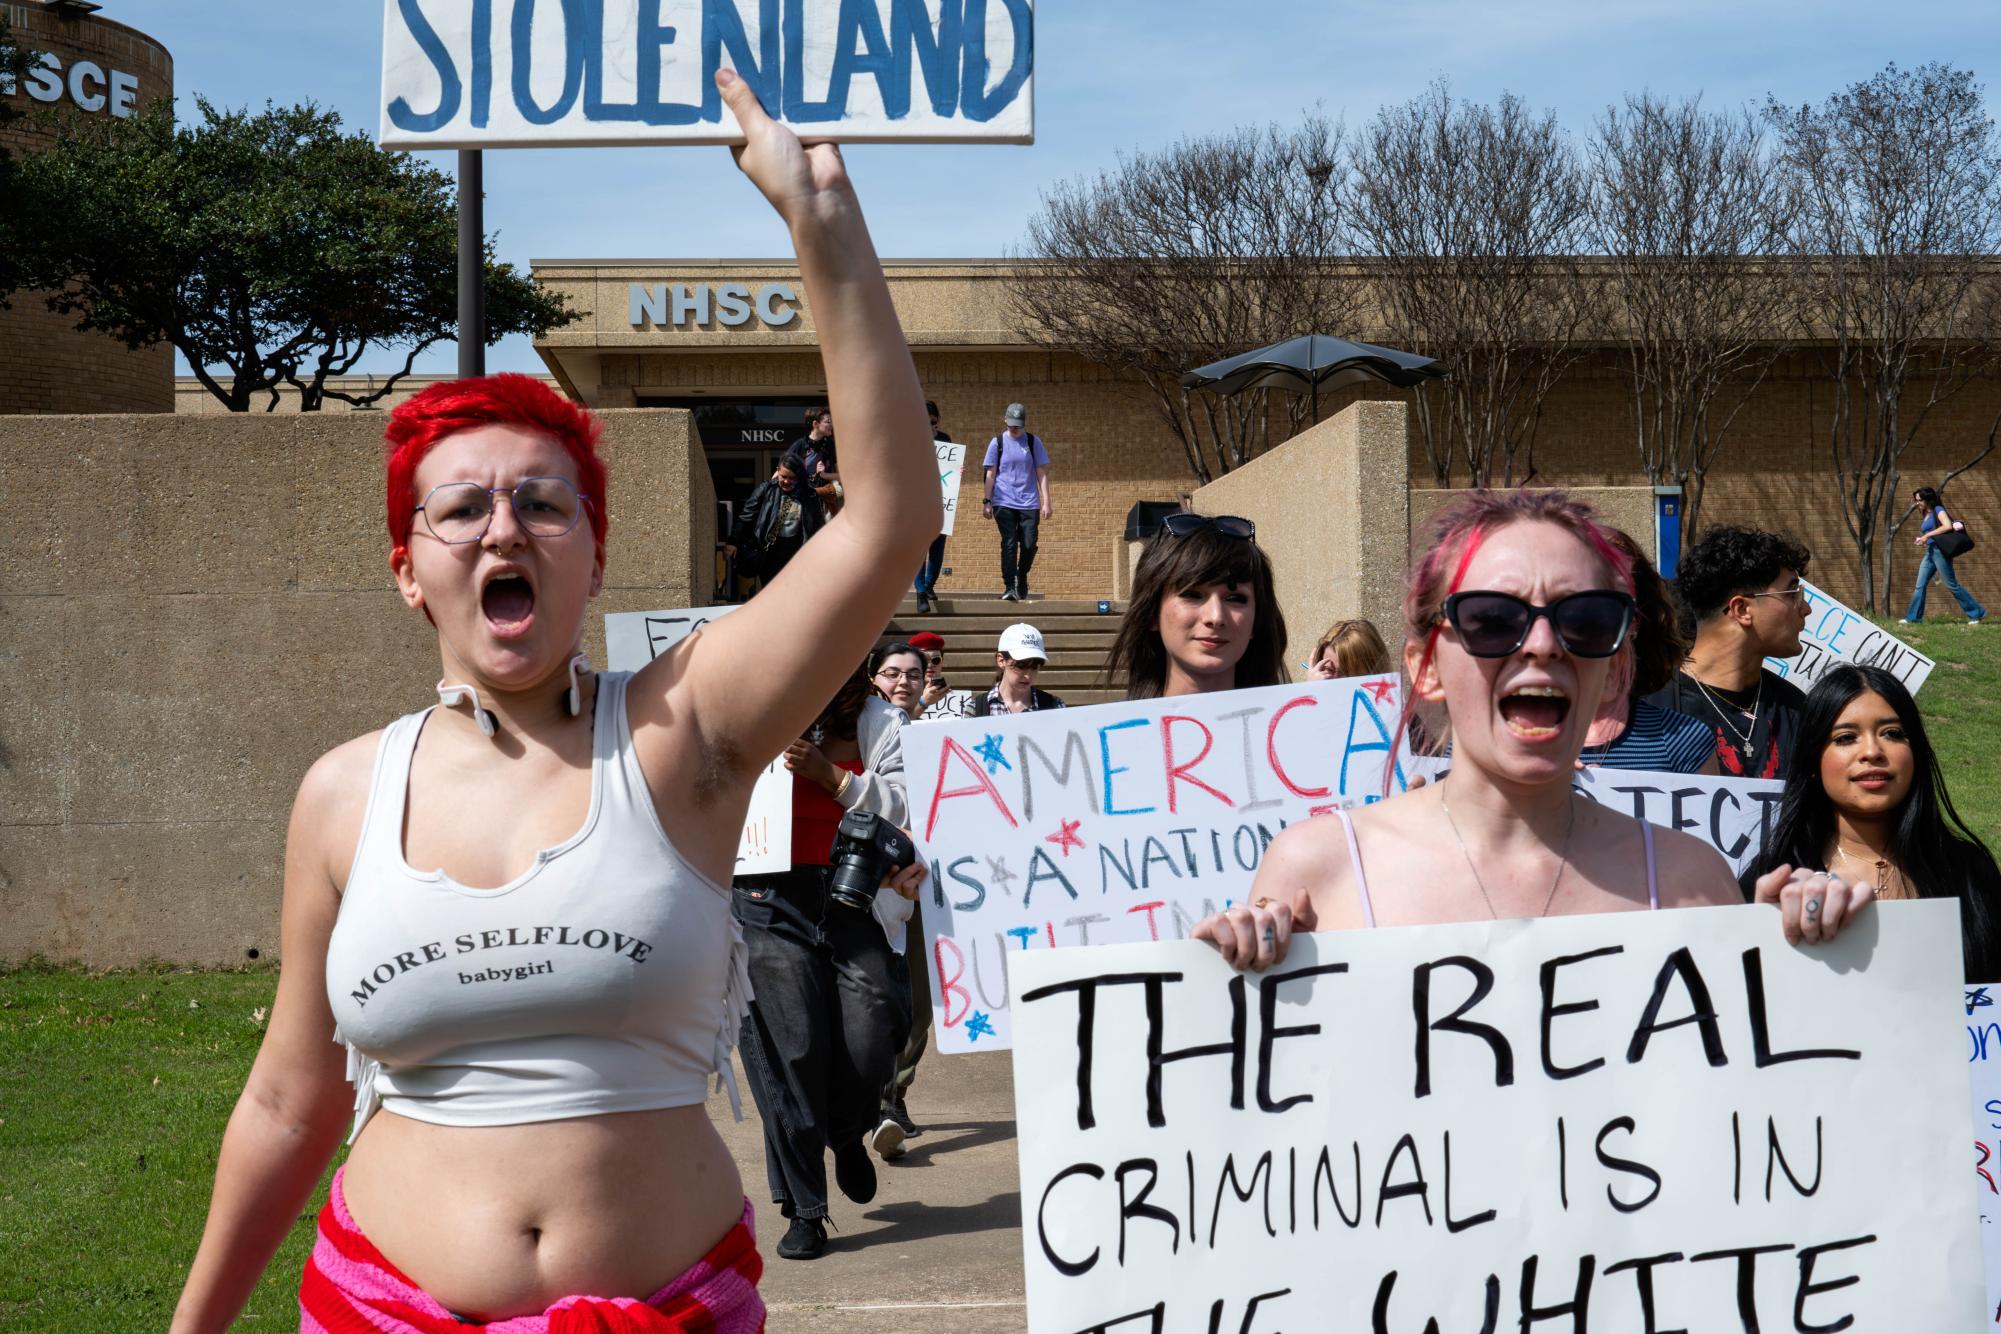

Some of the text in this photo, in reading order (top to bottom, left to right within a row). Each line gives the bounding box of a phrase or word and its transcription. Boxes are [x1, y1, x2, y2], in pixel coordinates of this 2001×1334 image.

[628, 283, 797, 326] NHSC
[741, 430, 785, 442] NHSC
[935, 694, 972, 714] UCK
[926, 688, 1407, 844] AMERICA
[931, 856, 986, 912] IS
[1023, 846, 1080, 908] A
[350, 941, 447, 1008] MORE
[458, 960, 555, 985] babygirl
[1022, 945, 1862, 1130] THE REAL
[1038, 1111, 1824, 1277] CRIMINAL IS IN
